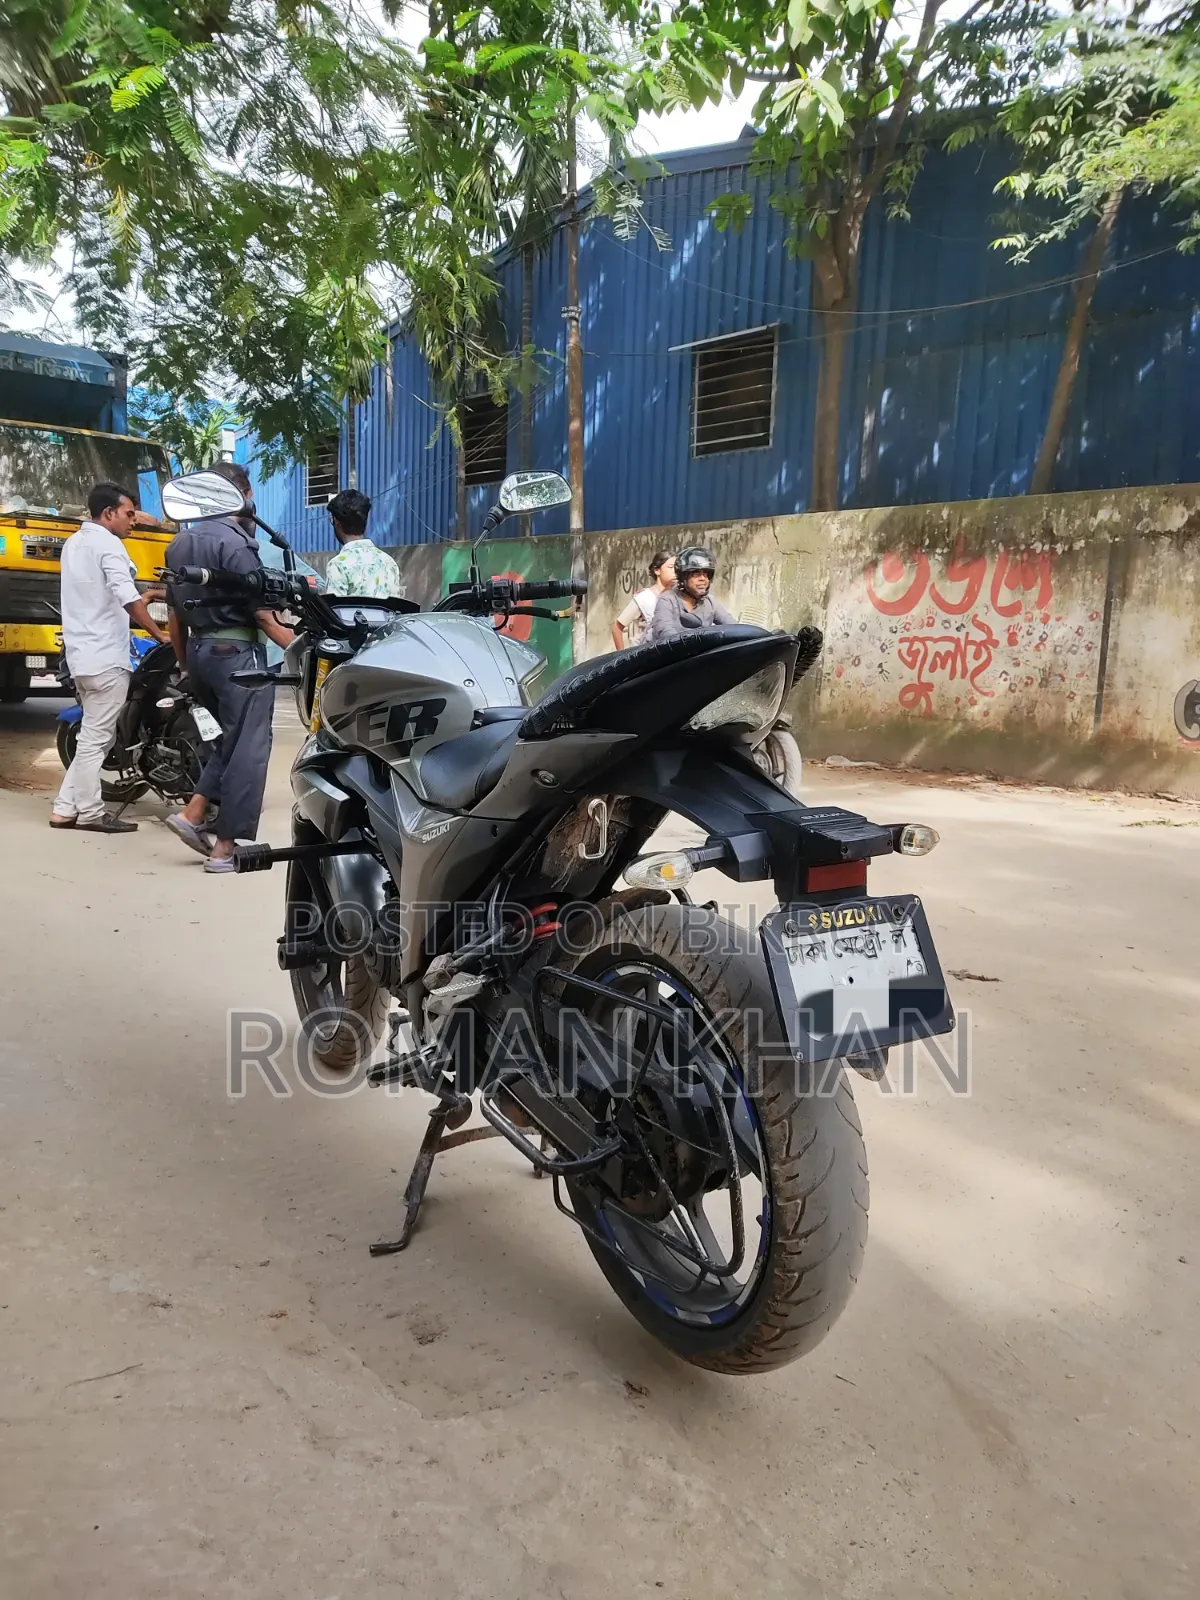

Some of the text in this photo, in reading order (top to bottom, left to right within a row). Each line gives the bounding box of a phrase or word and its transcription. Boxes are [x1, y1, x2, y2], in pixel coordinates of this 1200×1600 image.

[21, 534, 63, 543] ASHOK
[897, 614, 1000, 718] জুলাই
[421, 823, 451, 843] SUZUKI
[821, 905, 882, 928] SUZUKI
[785, 940, 827, 966] ঢাকা
